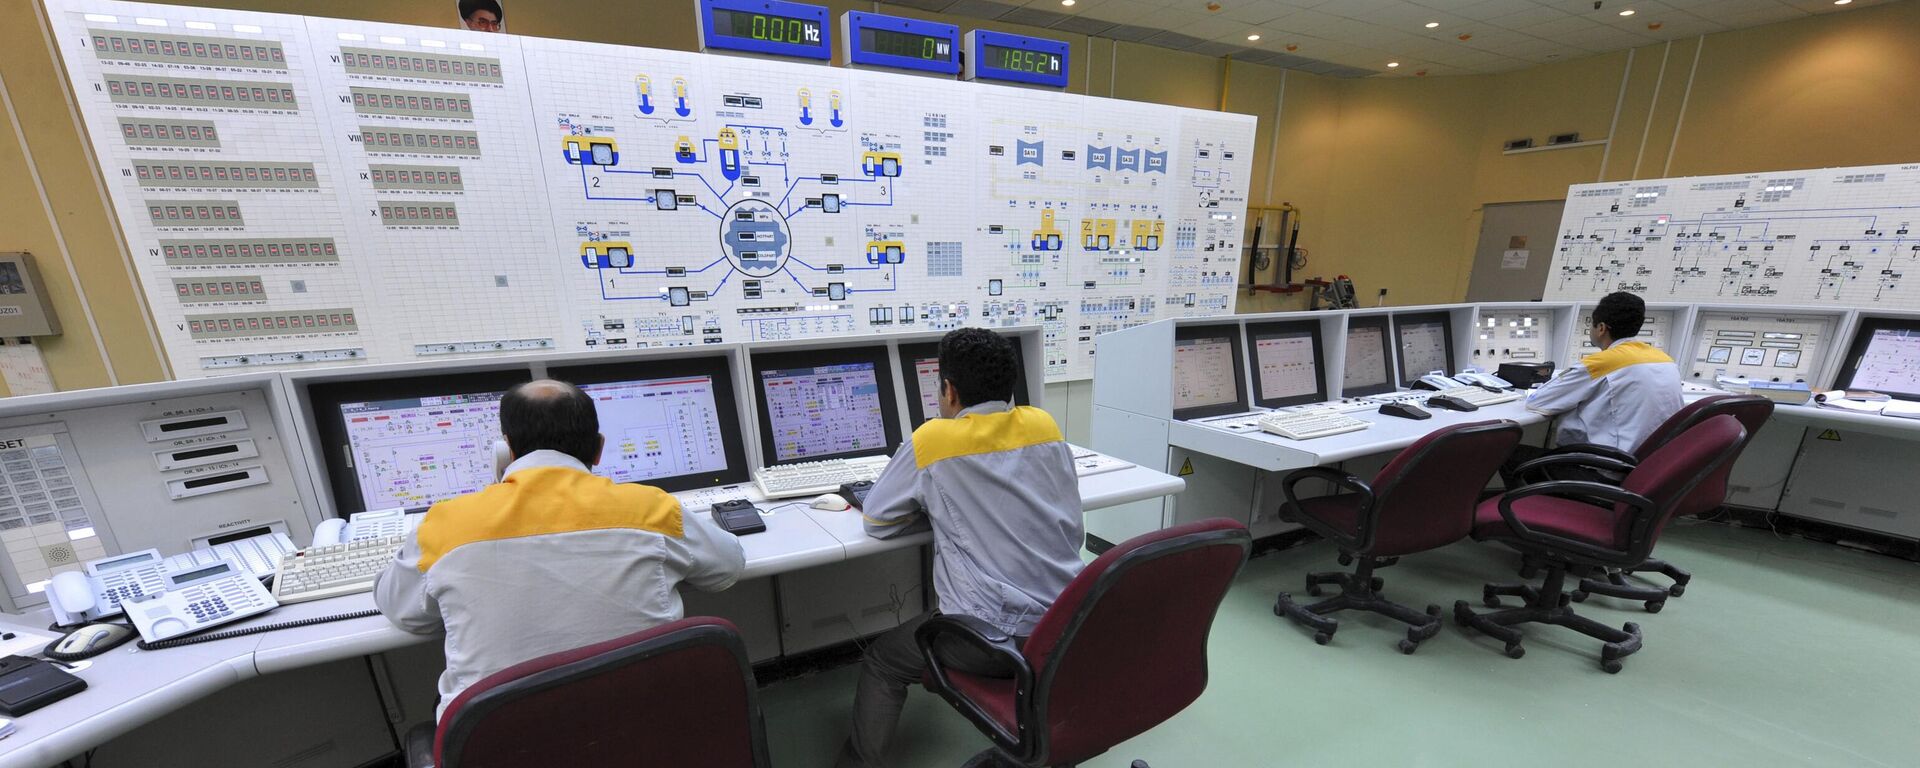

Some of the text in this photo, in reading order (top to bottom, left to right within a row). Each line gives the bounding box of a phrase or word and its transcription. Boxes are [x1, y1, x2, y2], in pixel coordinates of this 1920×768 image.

[752, 16, 820, 43] 0.00 Hz
[923, 38, 950, 59] 0 MW
[1004, 50, 1058, 73] 18.52 h
[94, 83, 102, 91] II
[593, 176, 600, 188] 2
[881, 186, 886, 196] 3
[884, 272, 889, 281] 4
[610, 279, 614, 288] 1
